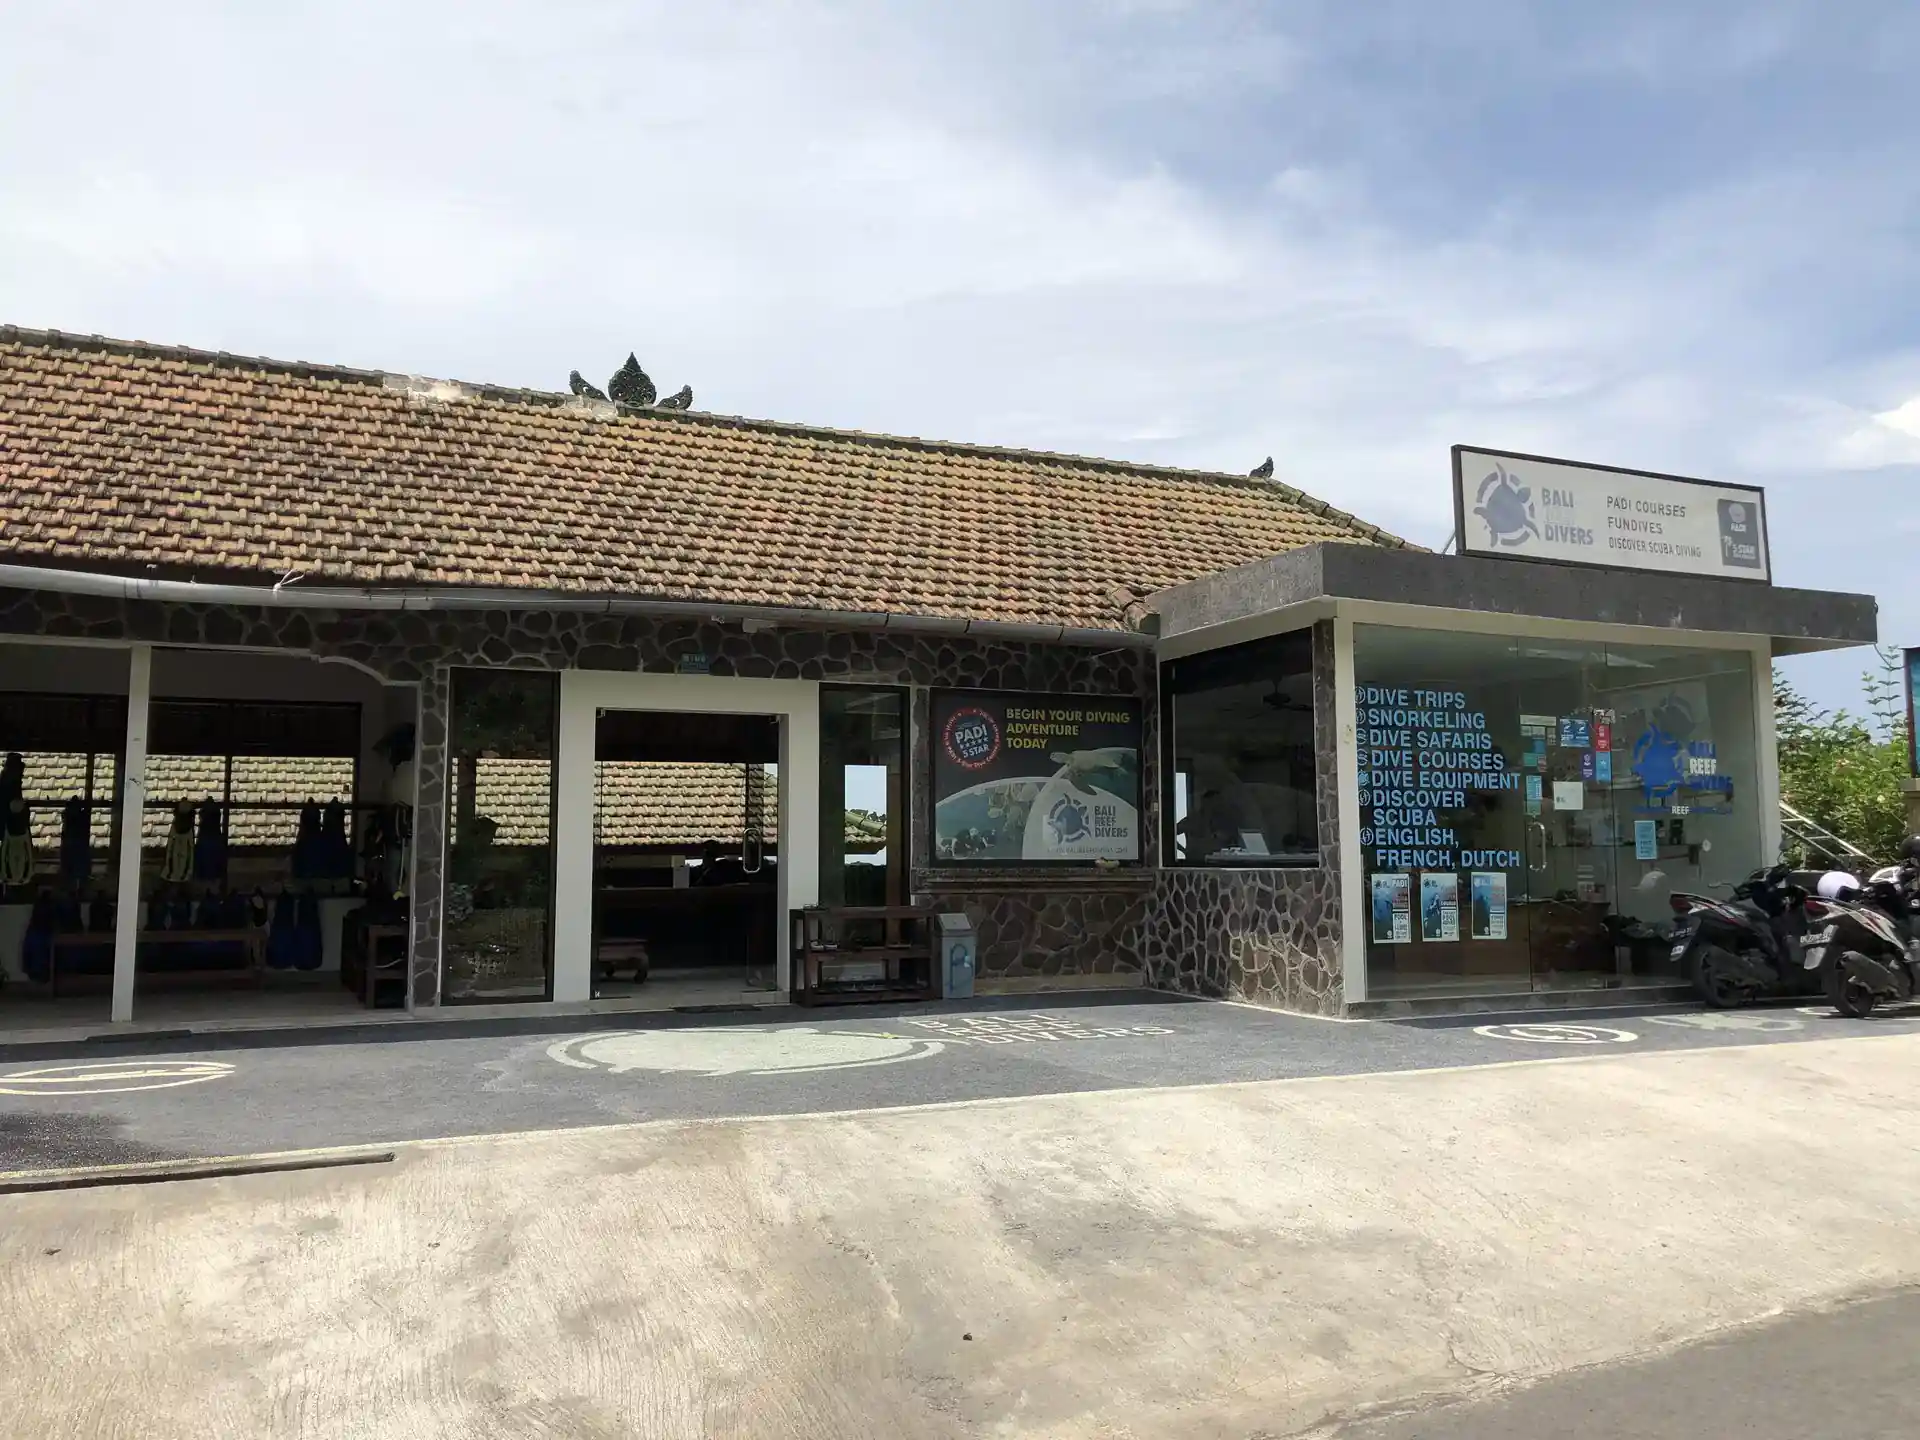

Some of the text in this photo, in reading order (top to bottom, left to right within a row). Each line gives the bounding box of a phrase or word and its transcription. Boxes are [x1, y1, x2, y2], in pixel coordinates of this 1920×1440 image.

[1541, 486, 1574, 508] BALI
[1606, 496, 1687, 518] PADI COURSES
[1544, 523, 1594, 547] DIVERS
[1607, 516, 1664, 535] FUNDIVES
[1608, 536, 1702, 558] DISCOVER SCUBA DIVING
[1367, 687, 1466, 709] DIVE TRIPS
[1006, 708, 1130, 723] BEGIN YOUR DIVING
[1368, 708, 1486, 730] SNORKELING
[954, 723, 987, 744] PADI
[1006, 722, 1080, 736] ADVENTURE
[1006, 737, 1049, 749] TODAY
[1369, 729, 1492, 750] DIVE SAFARIS
[962, 744, 990, 758] 5 STAR
[1371, 750, 1504, 770] DIVE COURSES
[1689, 758, 1717, 775] REEF
[1372, 771, 1413, 787] DIVE
[1419, 771, 1521, 789] EQUIPMENT
[1372, 790, 1465, 807] DISCOVER
[1094, 805, 1116, 817] BALI
[1373, 809, 1437, 826] SCUBA
[1094, 826, 1128, 838] DIVERS
[1375, 828, 1459, 848] ENGLISH,
[1376, 849, 1521, 870] FRENCH, DUTCH
[968, 1026, 1174, 1044] DIVERS
